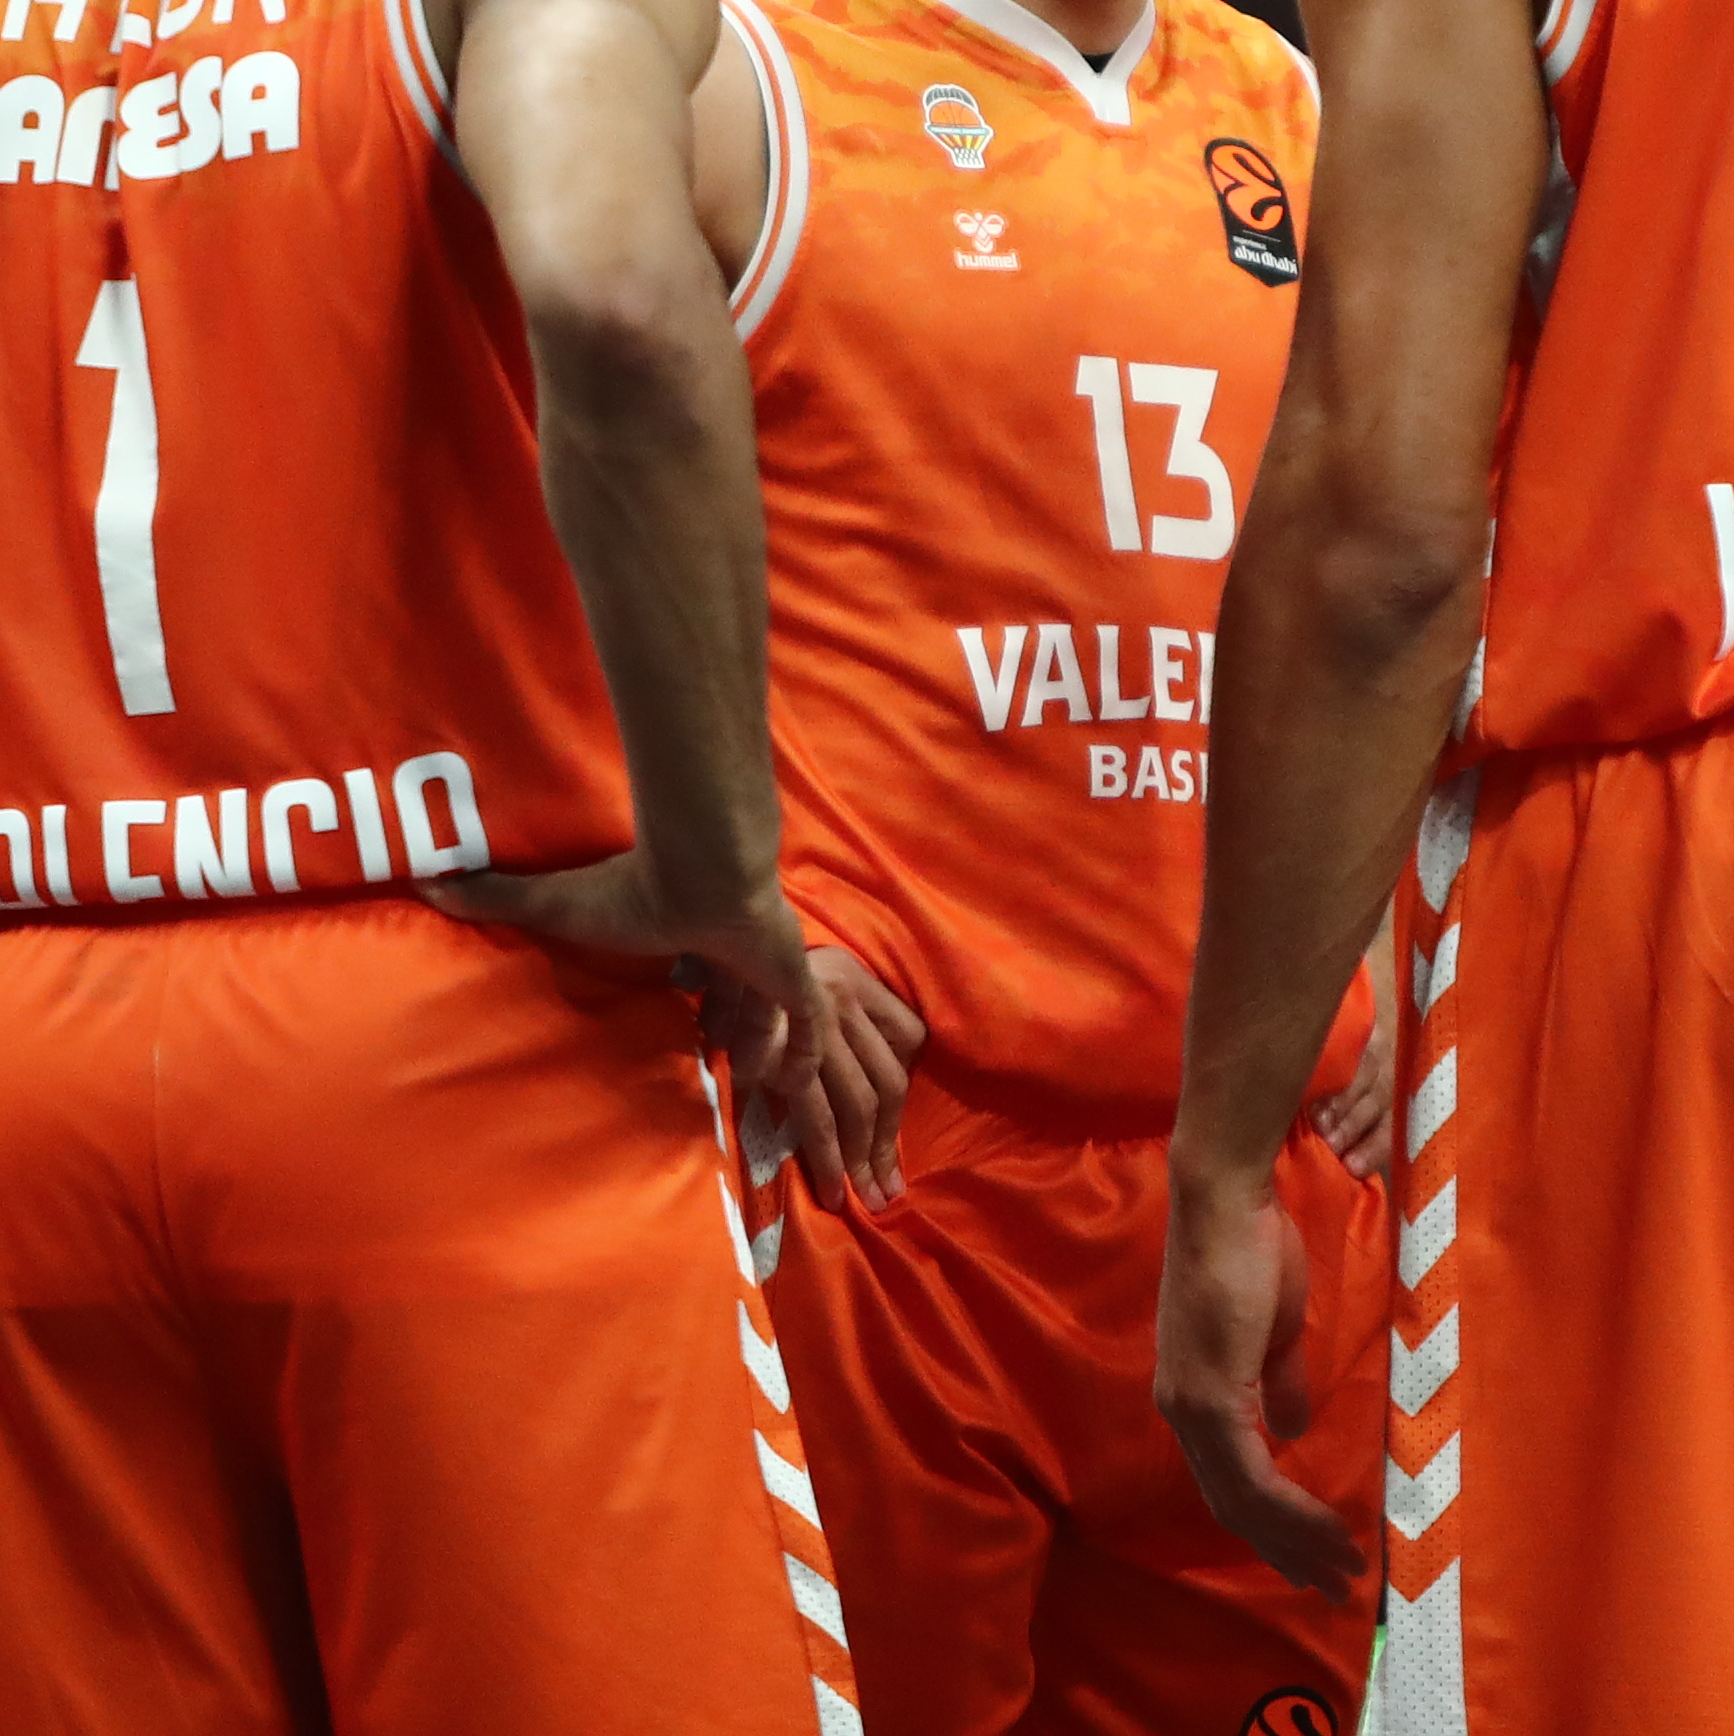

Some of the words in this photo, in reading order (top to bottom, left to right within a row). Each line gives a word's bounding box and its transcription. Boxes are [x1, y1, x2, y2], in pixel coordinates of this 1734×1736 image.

[956, 251, 1019, 268] hummel
[1234, 245, 1261, 265] abu
[1261, 251, 1298, 275] dhabi
[1075, 355, 1236, 562] 13
[74, 275, 176, 716] 1
[1088, 744, 1209, 804] BAS
